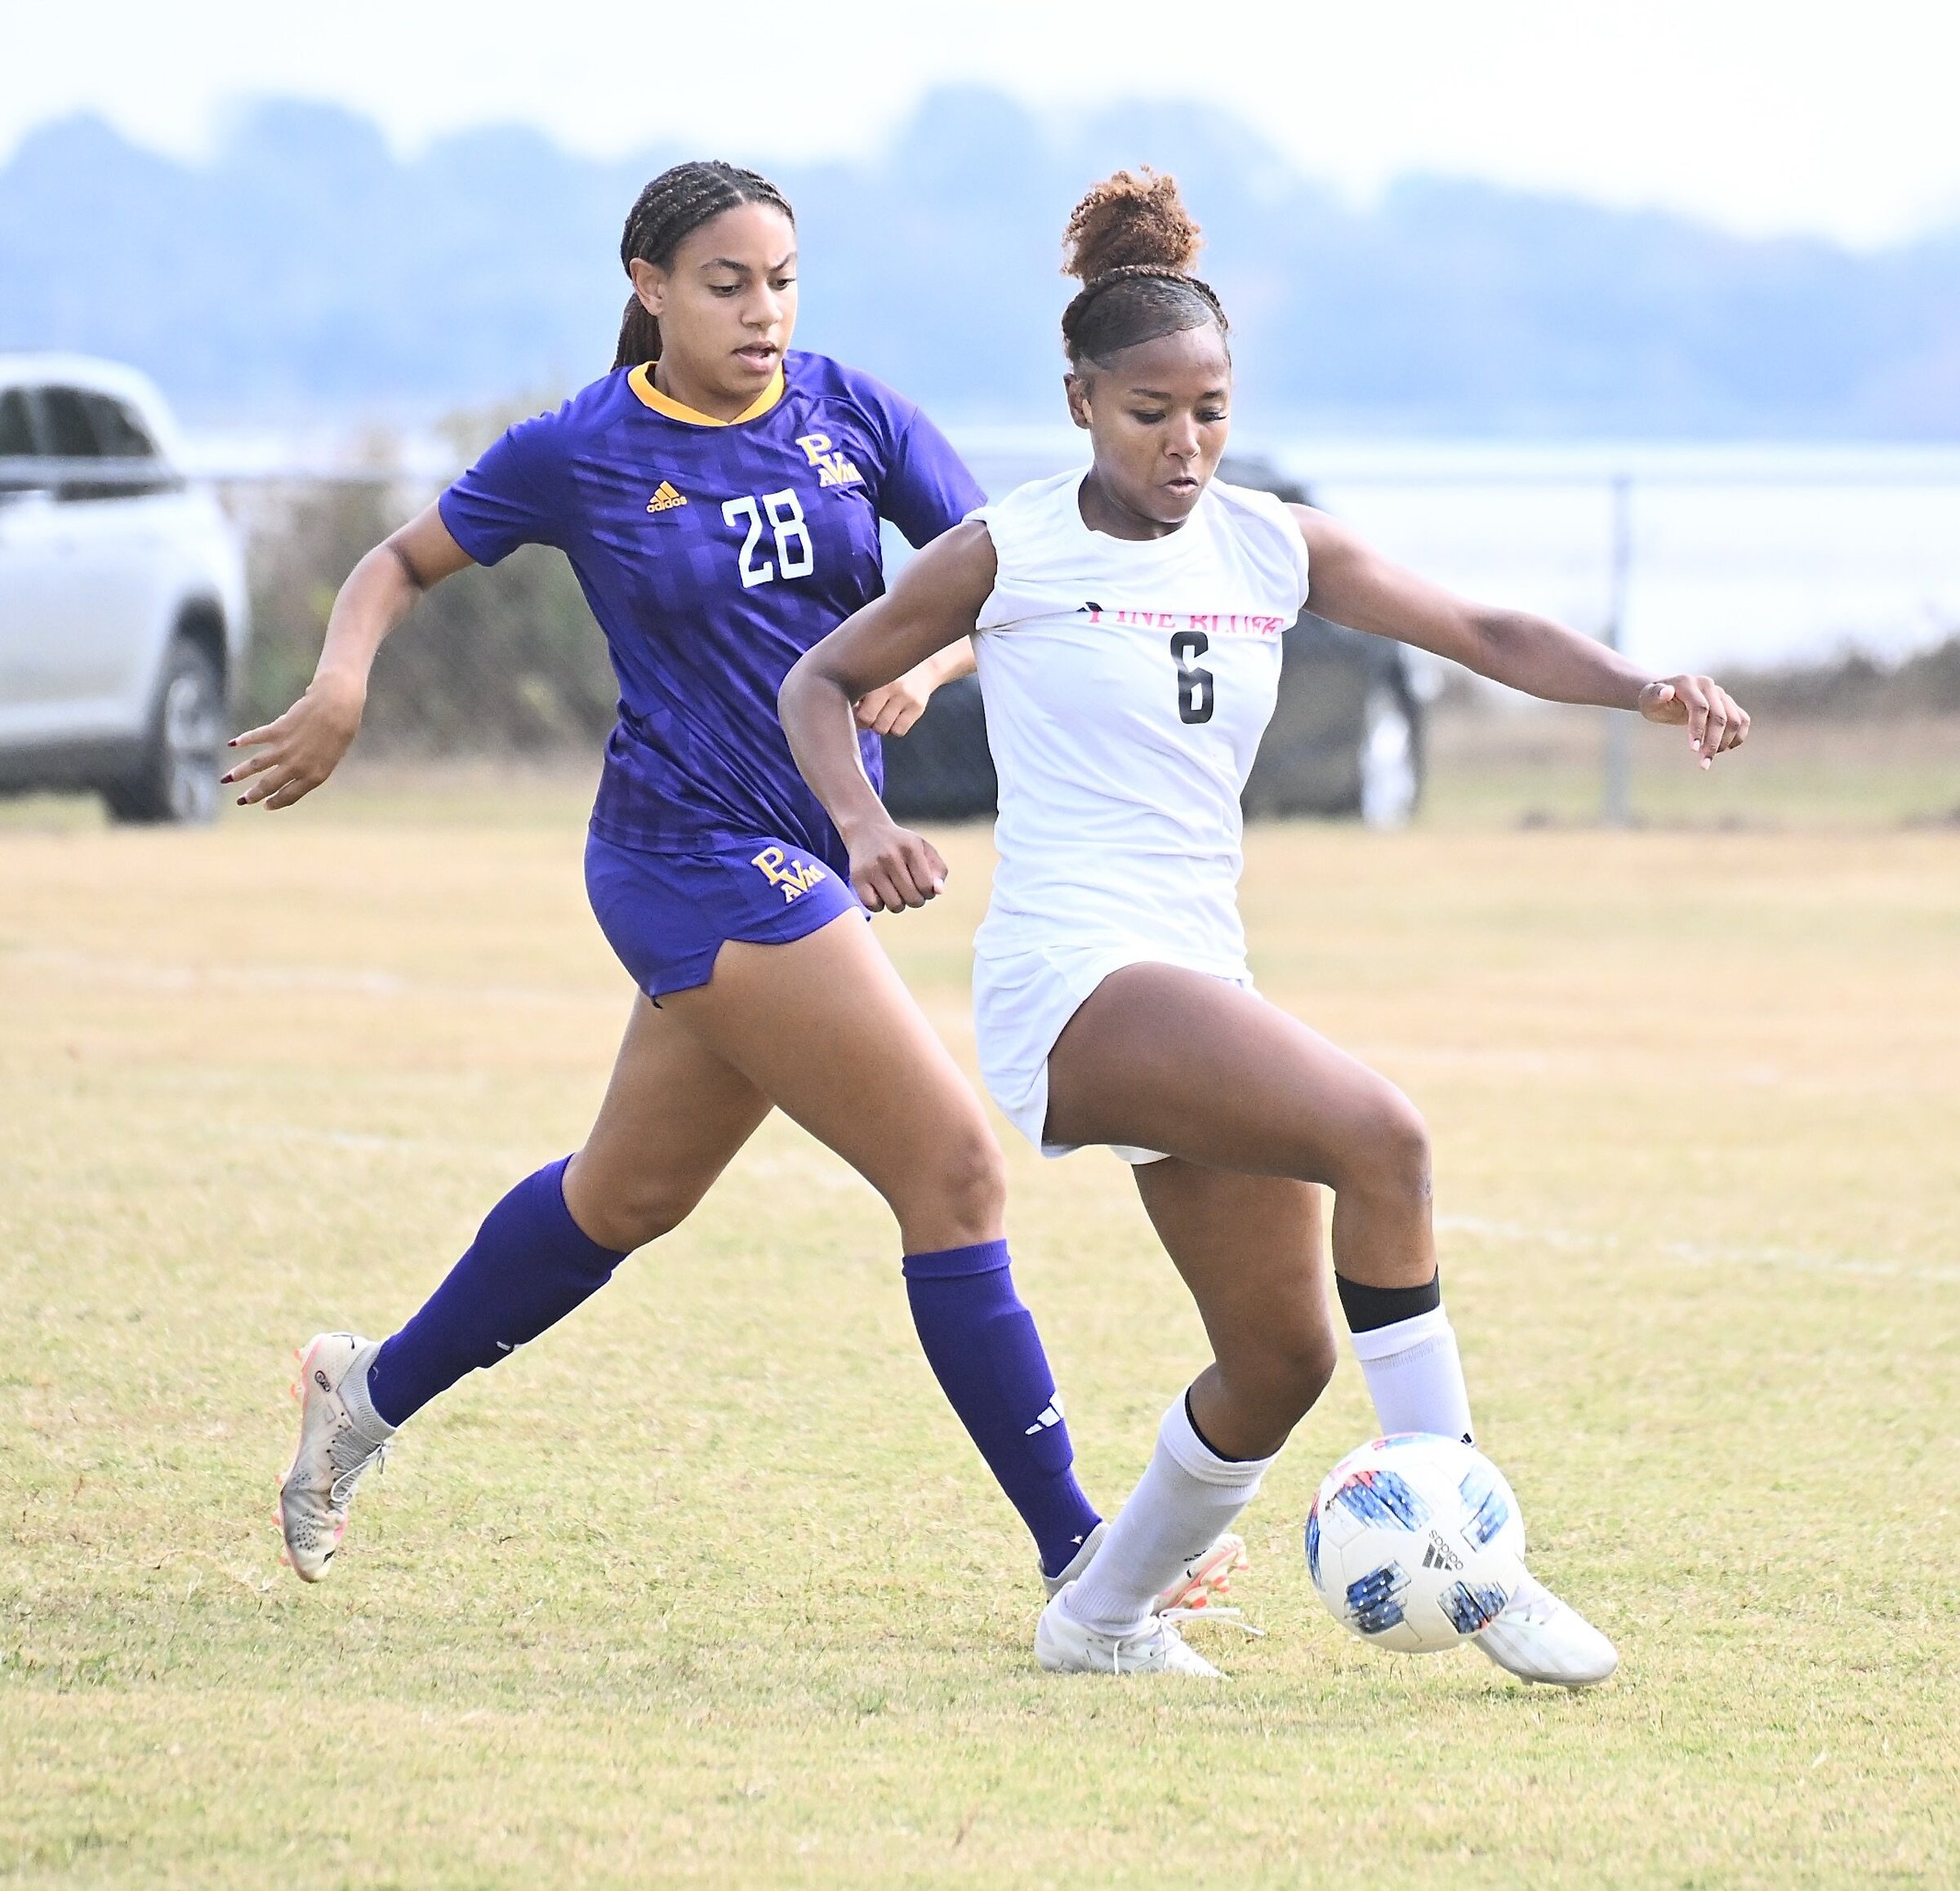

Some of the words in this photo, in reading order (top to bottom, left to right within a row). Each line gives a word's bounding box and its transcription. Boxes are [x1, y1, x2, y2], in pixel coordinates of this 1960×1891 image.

[646, 496, 688, 513] adidas
[721, 488, 813, 588] 28
[1170, 631, 1214, 724] 6
[1428, 1528, 1463, 1571] adidas
